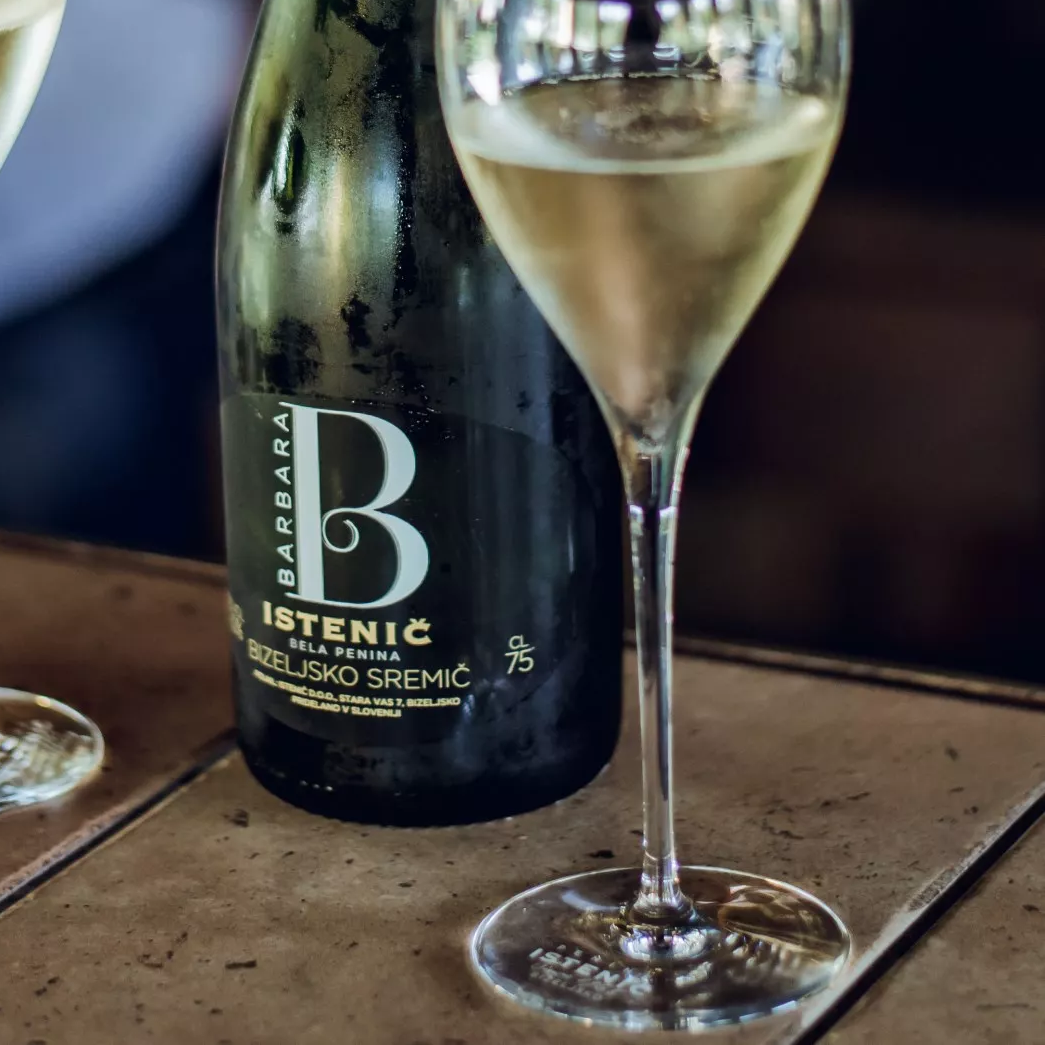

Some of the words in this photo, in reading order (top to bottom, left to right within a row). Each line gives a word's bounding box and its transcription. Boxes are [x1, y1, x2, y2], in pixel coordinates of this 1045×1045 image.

[272, 412, 296, 587] BARBARA
[279, 401, 429, 609] B
[262, 600, 433, 646] ISTENIČ
[247, 638, 359, 687] BIZELJSKO
[367, 662, 471, 690] SREMIČ
[289, 637, 328, 655] BELA
[335, 646, 401, 661] PENINA
[504, 646, 535, 674] 75
[339, 694, 372, 705] STARA
[372, 697, 394, 707] VAS
[406, 697, 461, 708] BIZELJSKO
[341, 705, 351, 714] V
